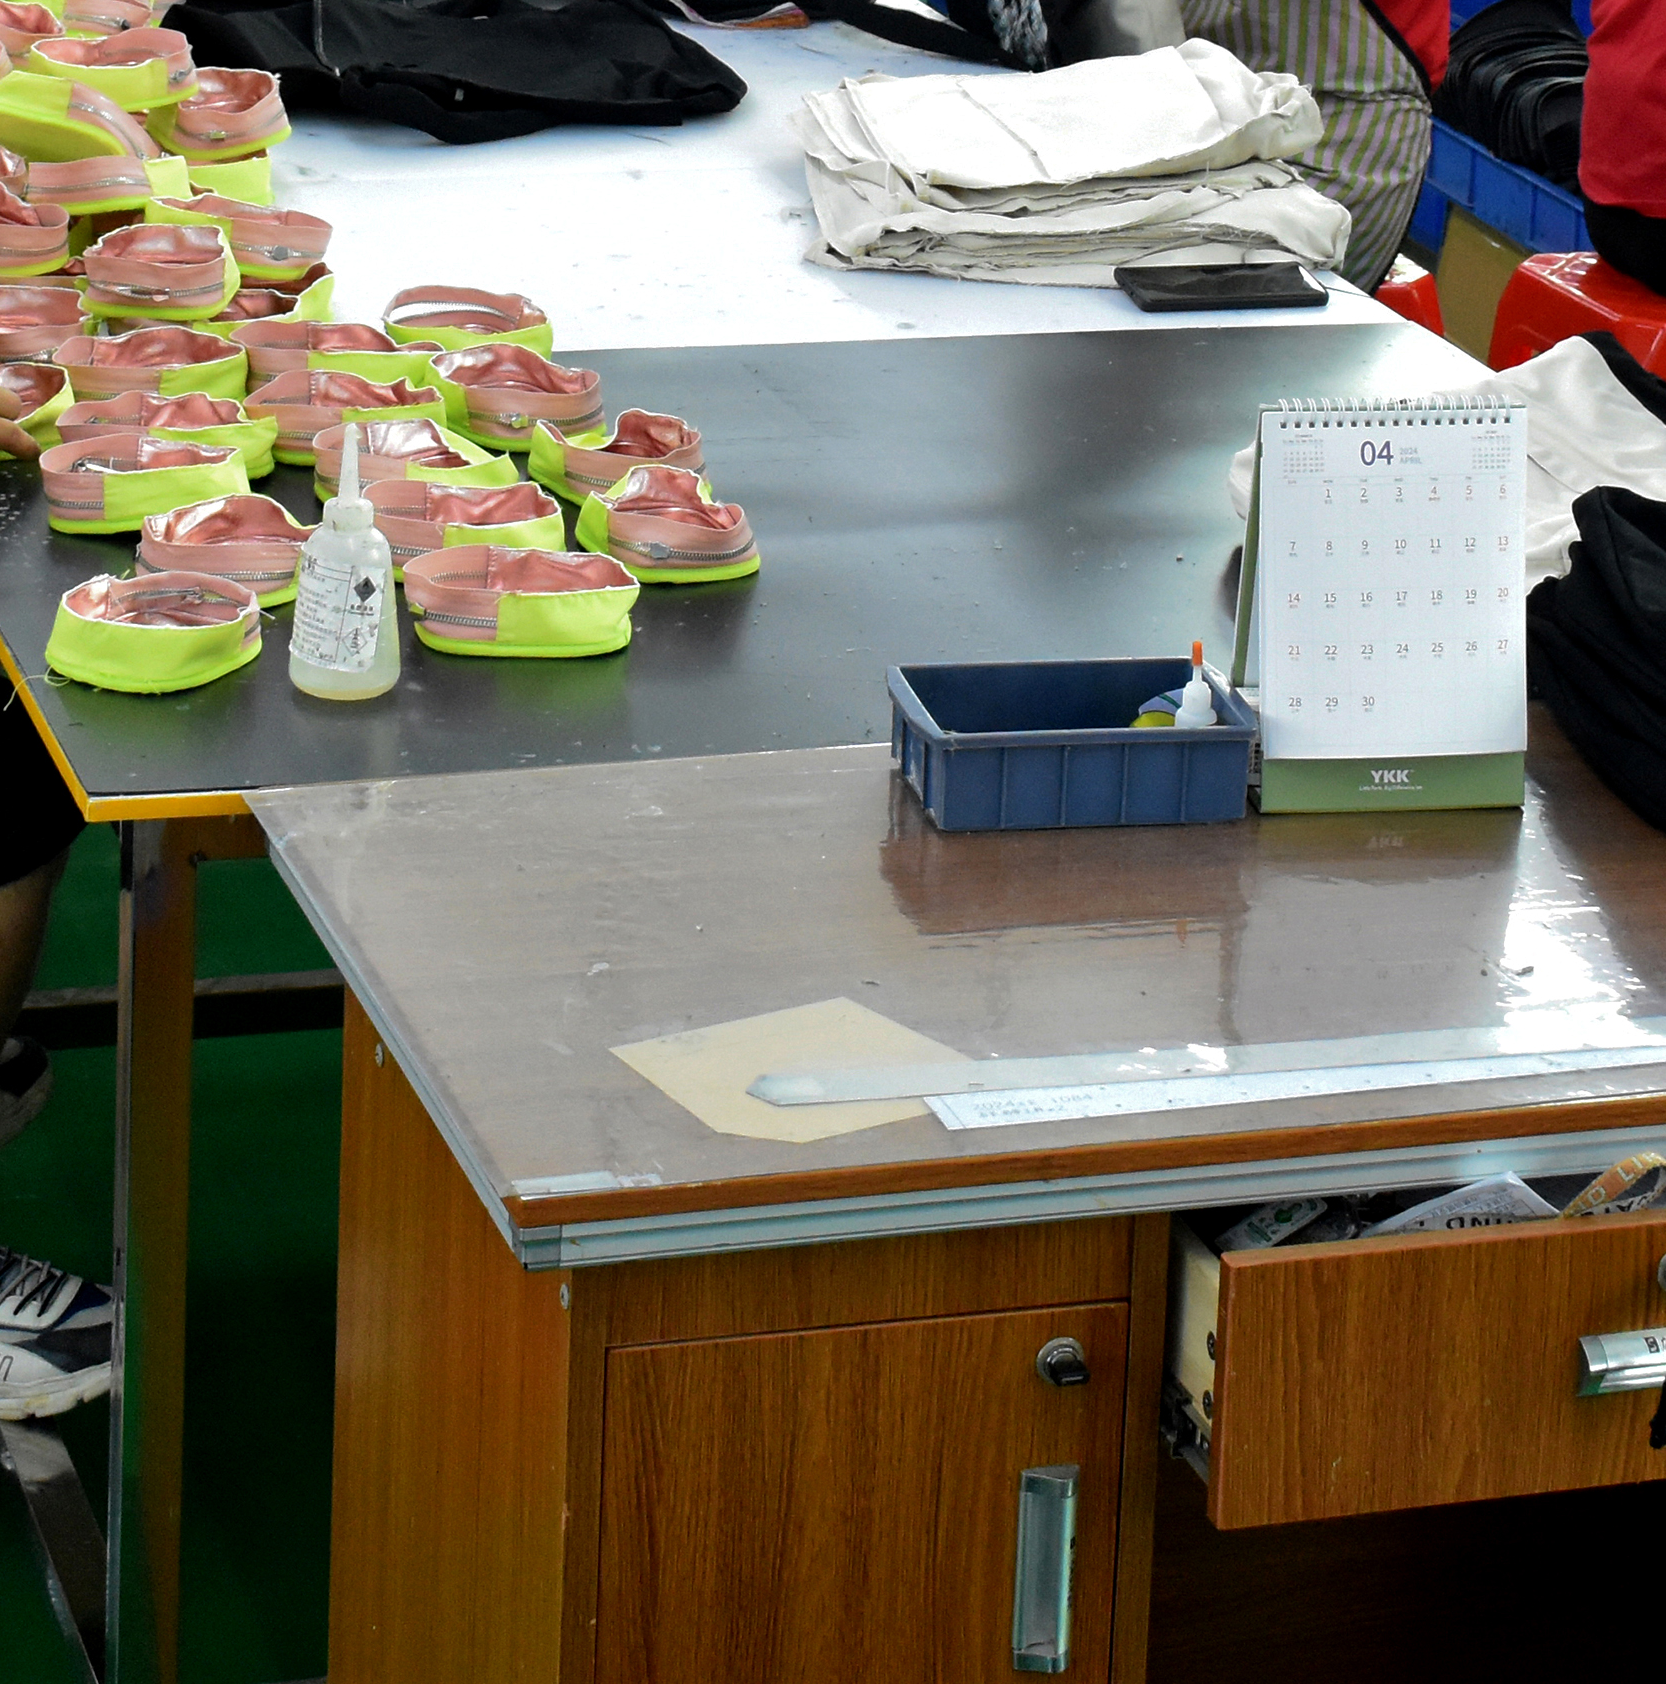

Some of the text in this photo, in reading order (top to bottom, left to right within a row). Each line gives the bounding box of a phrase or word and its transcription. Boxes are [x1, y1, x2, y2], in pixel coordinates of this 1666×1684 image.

[1359, 439, 1419, 466] 04 2024
[1325, 483, 1507, 499] 1 2 3 4 5 6
[1289, 535, 1509, 551] 7 8 9 10 11 12 13
[1288, 587, 1509, 603] 14 15 16 17 18 19 20
[1288, 639, 1509, 656] 21 22 23 24 25 26 27
[1288, 695, 1375, 708] 28 29 30
[1370, 769, 1410, 784] YKK
